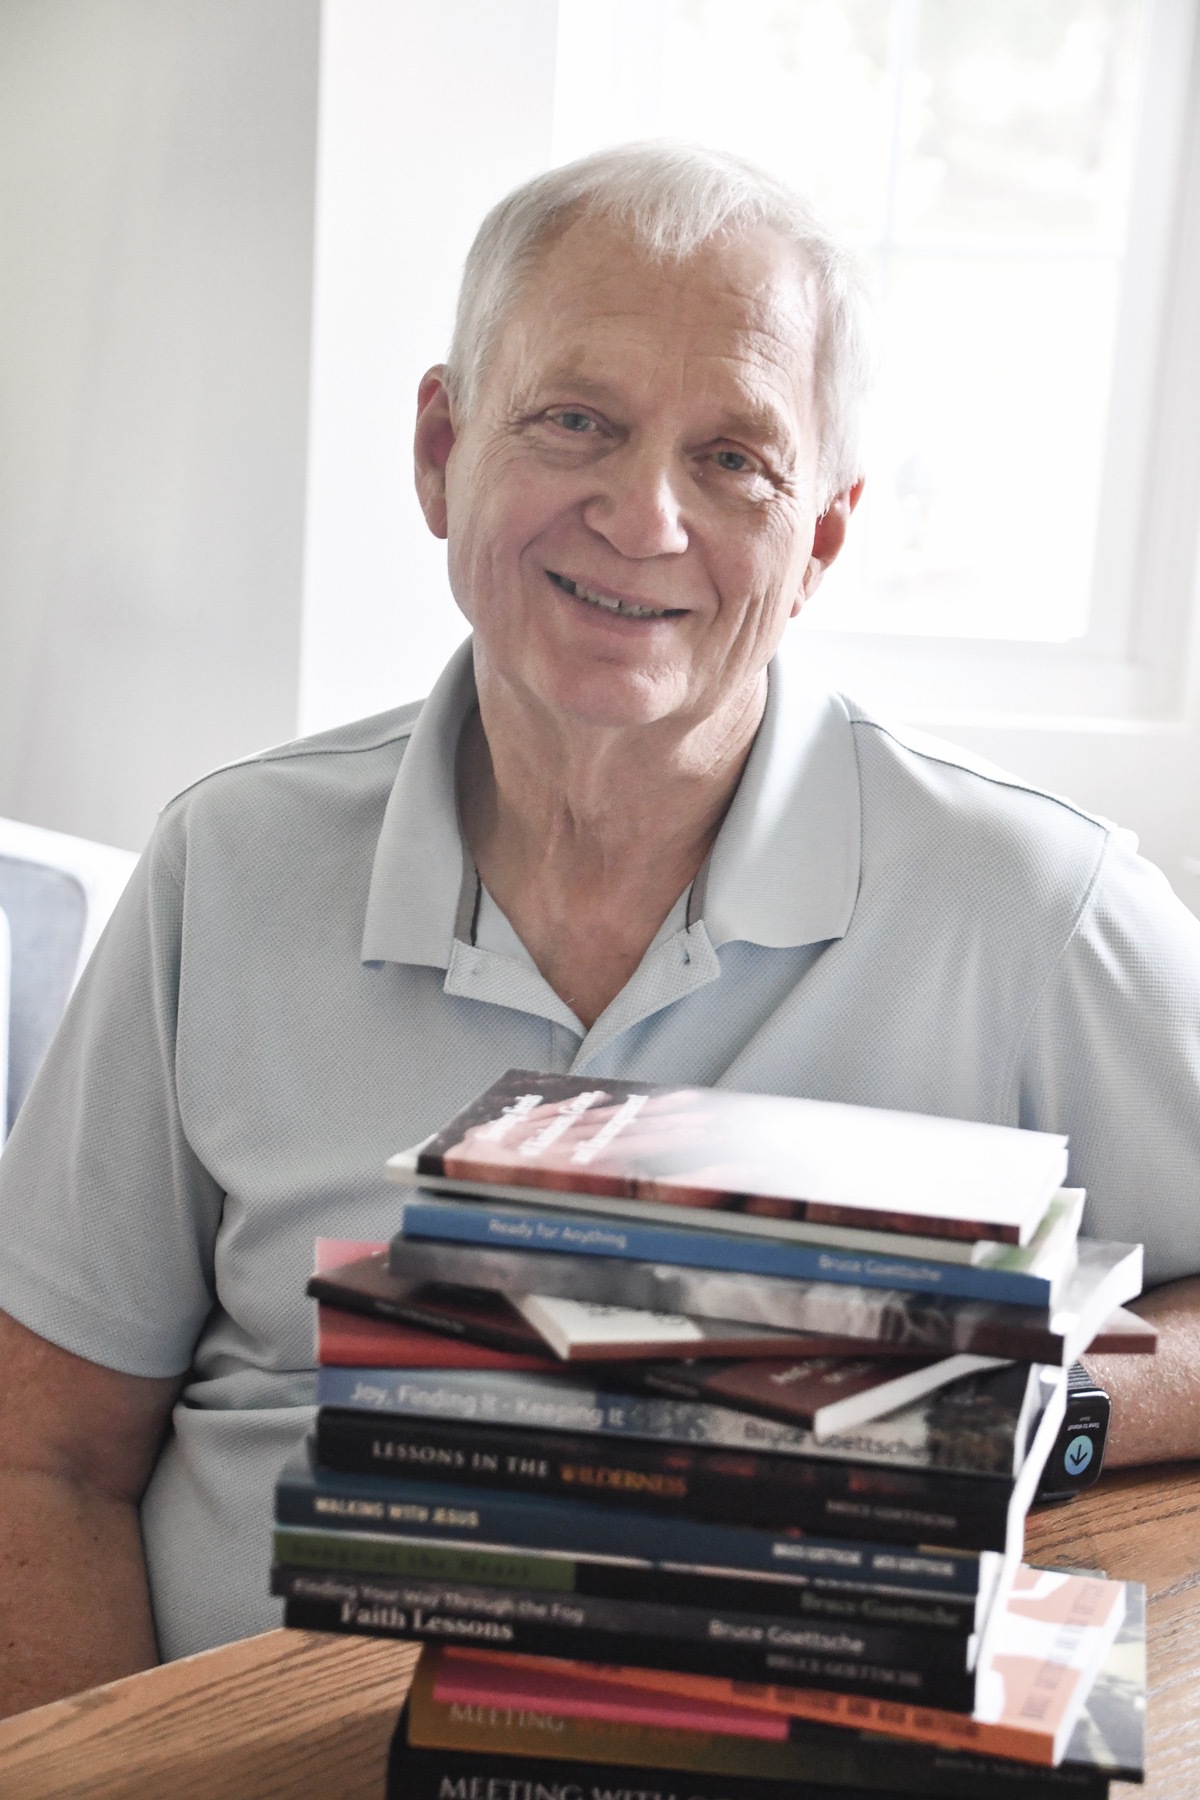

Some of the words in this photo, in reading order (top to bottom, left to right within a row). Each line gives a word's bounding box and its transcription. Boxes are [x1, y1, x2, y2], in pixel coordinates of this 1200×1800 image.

[488, 1218, 533, 1239] Ready
[536, 1222, 559, 1239] for
[562, 1226, 627, 1249] Anything
[371, 1440, 465, 1467] LESSONS
[471, 1452, 499, 1472] IN
[504, 1454, 550, 1479] THE
[558, 1463, 689, 1496] WILDERNESS
[340, 1601, 406, 1630] Faith
[413, 1608, 514, 1641] Lessons
[708, 1619, 764, 1642] Bruce
[438, 1775, 585, 1800] MEETING
